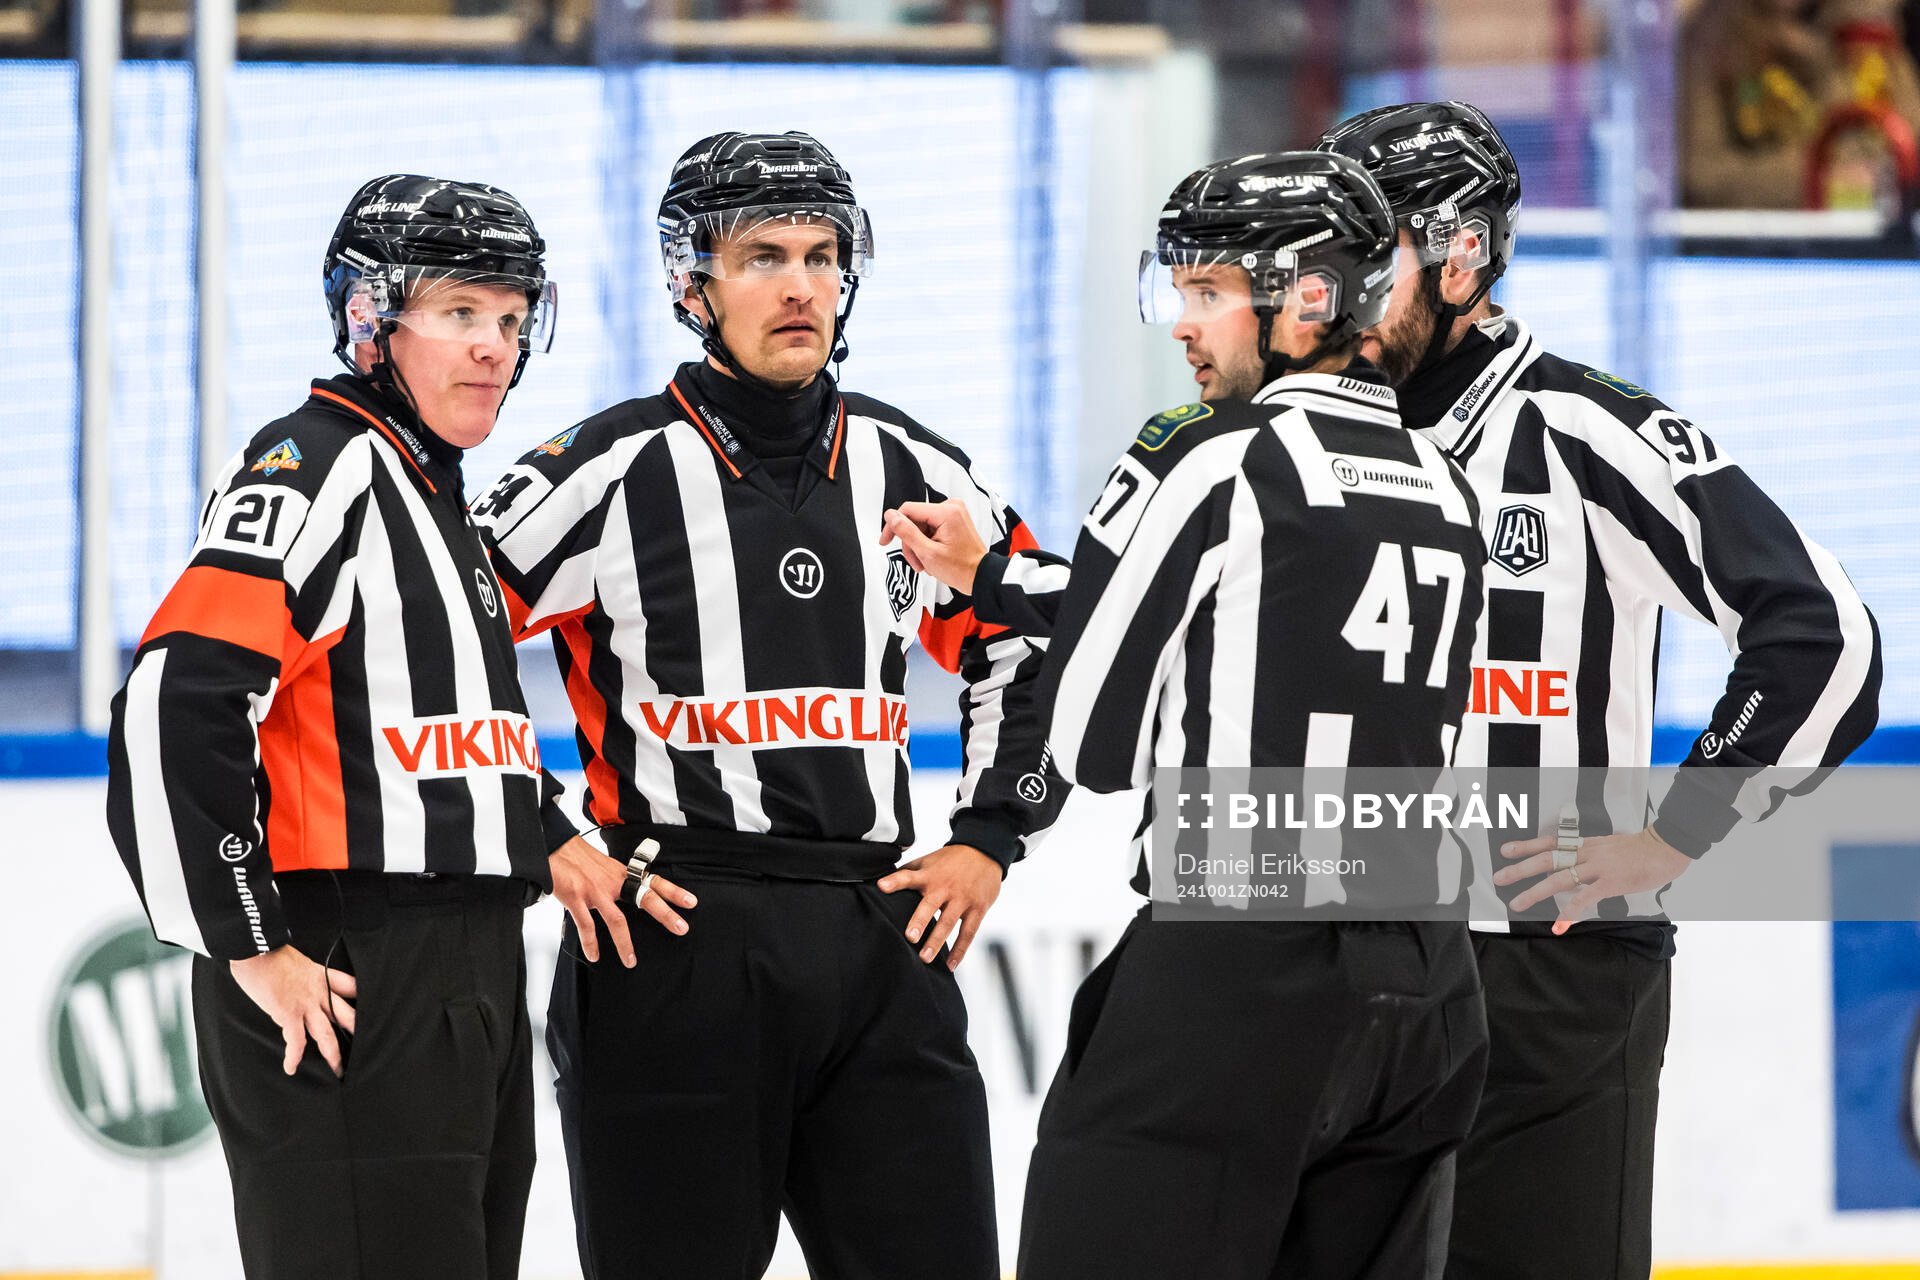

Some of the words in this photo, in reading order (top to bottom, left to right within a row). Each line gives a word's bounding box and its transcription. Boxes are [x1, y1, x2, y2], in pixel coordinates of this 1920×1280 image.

[1295, 176, 1328, 188] LINE
[1460, 384, 1479, 407] HOCKEY
[1467, 371, 1497, 411] ALLSVENSKAN
[698, 405, 728, 444] ALLSVENSKAN
[713, 416, 733, 440] HOCKEY
[1658, 418, 1718, 465] 97
[1363, 470, 1434, 490] WARRIOR
[224, 493, 285, 547] 21
[1340, 541, 1467, 689] 47
[1465, 667, 1570, 716] INE
[639, 694, 844, 745] VIKING
[381, 719, 536, 772] VIKING
